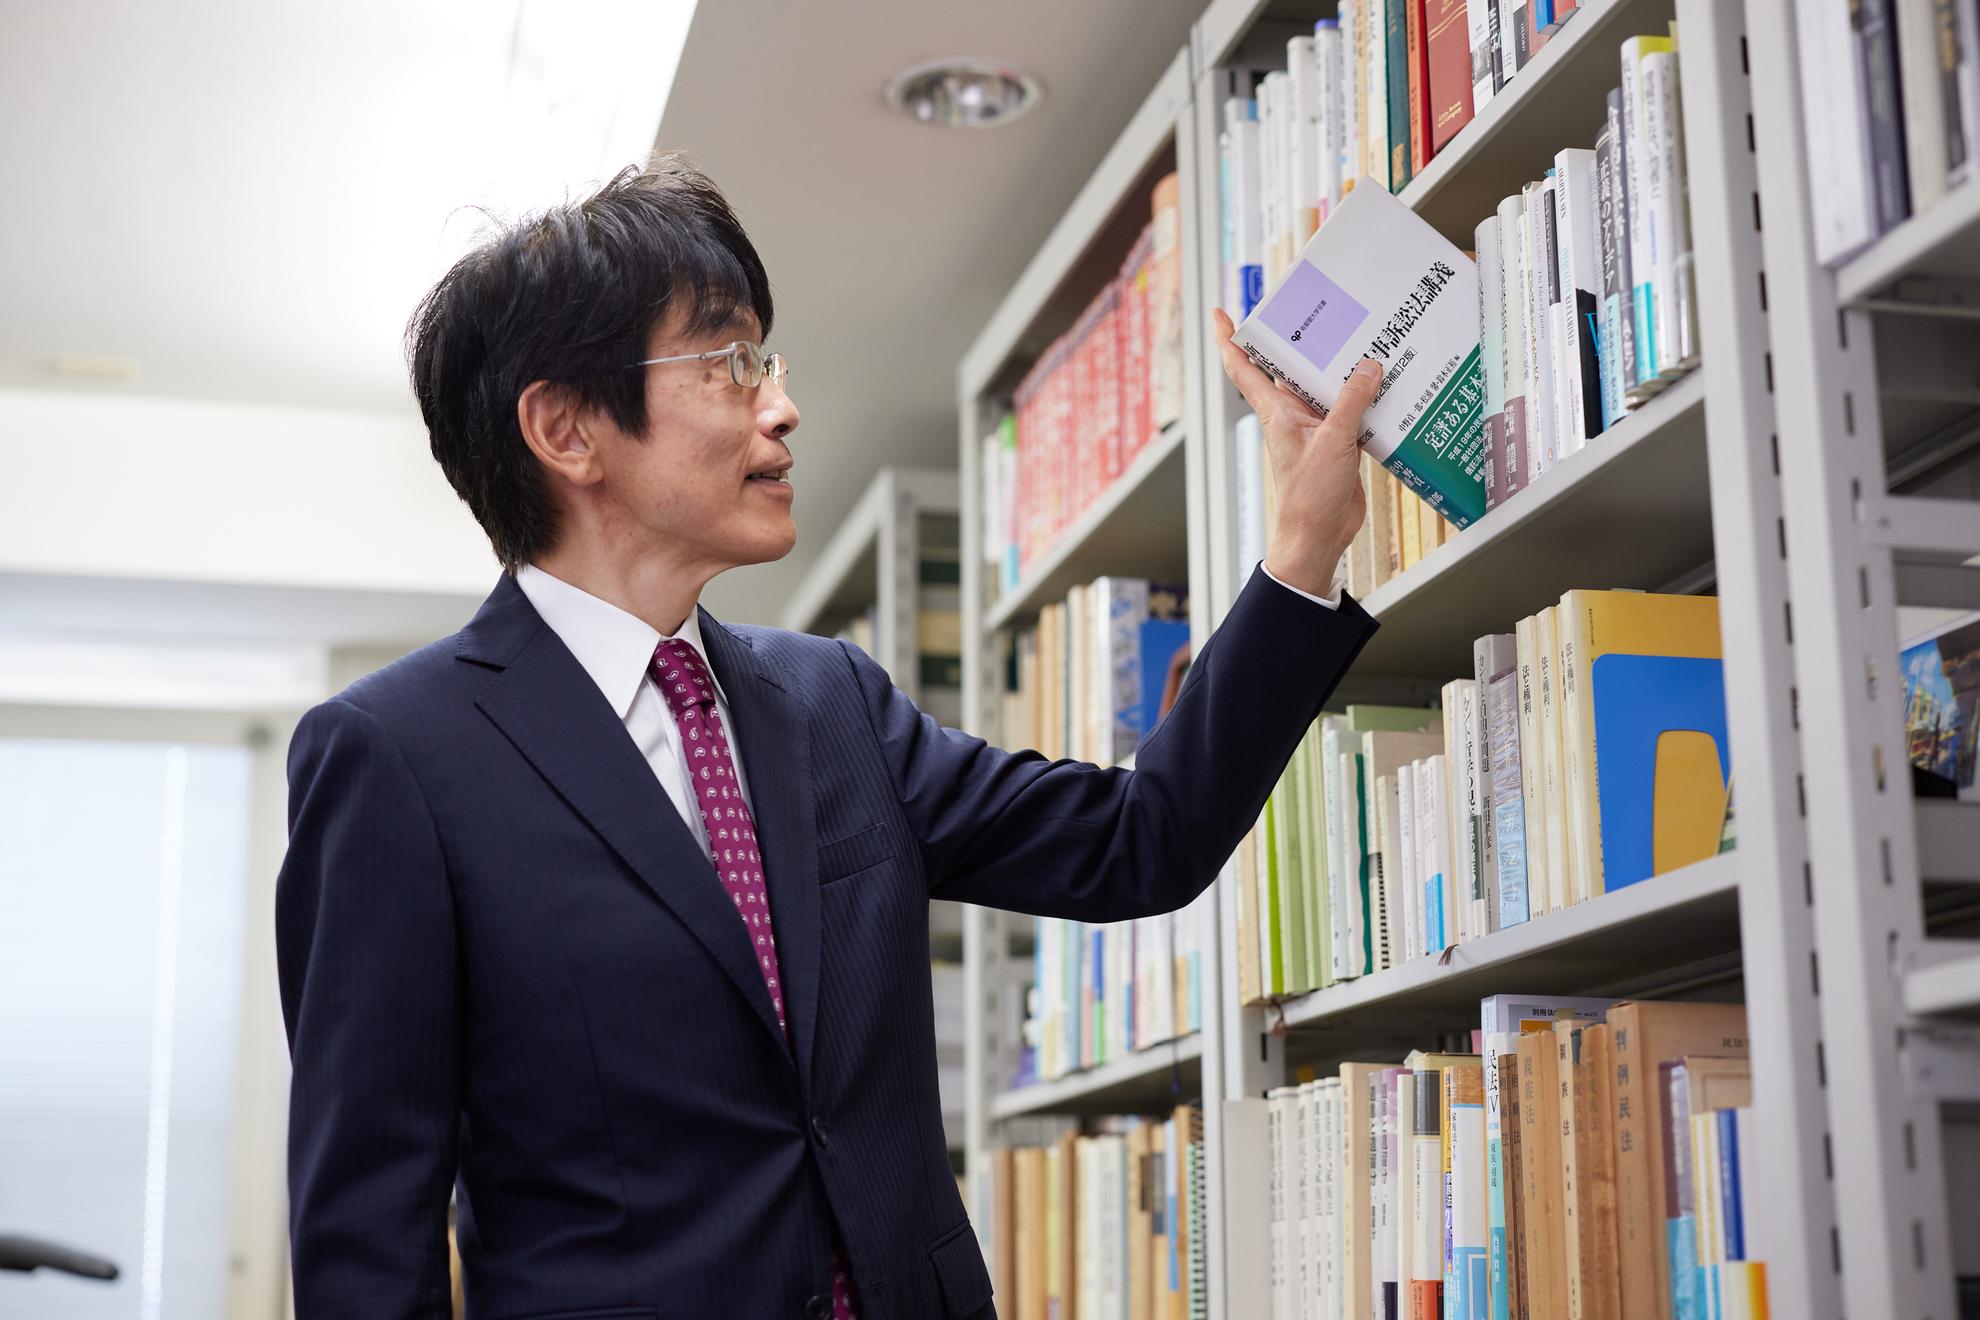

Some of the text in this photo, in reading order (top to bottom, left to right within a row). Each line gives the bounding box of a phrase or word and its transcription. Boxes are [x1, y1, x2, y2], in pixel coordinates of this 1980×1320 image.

[1599, 156, 1615, 292] 正義のアイデア
[1343, 260, 1456, 384] 事訴訟法講義
[1566, 296, 1575, 347] REEXAMINED
[1424, 360, 1485, 453] 定評ある基本
[1478, 654, 1490, 774] カントと自由の問題
